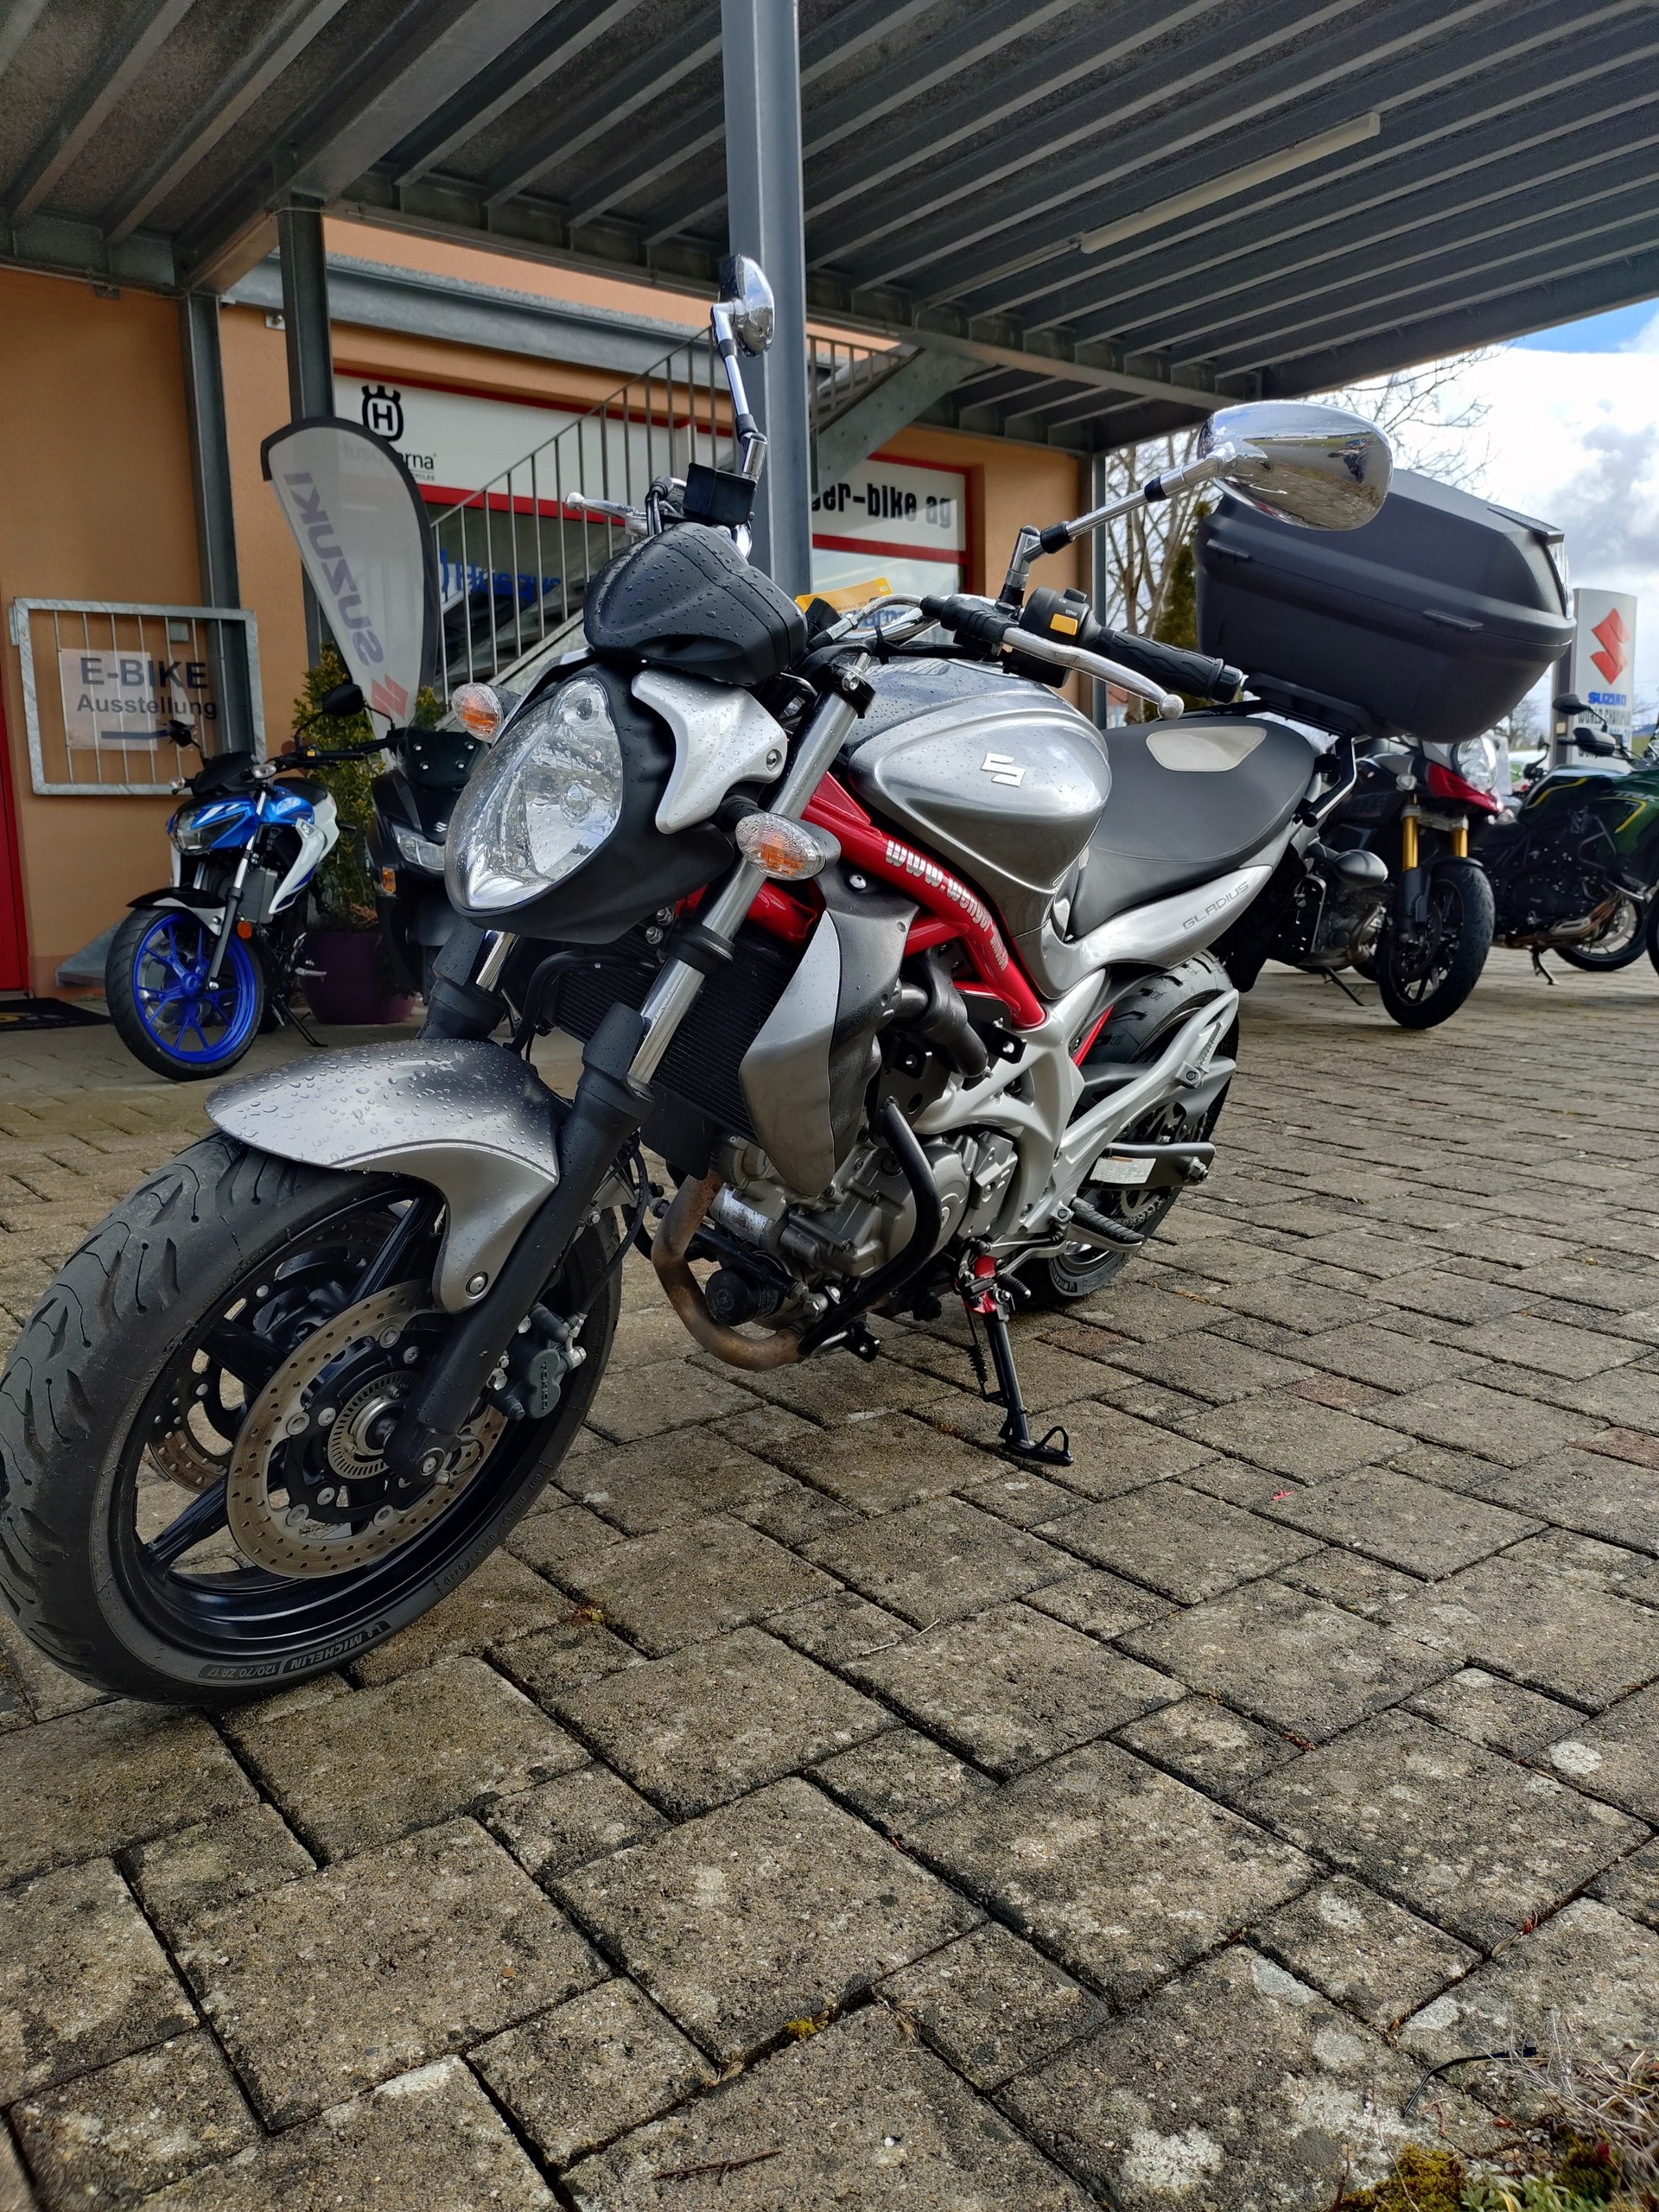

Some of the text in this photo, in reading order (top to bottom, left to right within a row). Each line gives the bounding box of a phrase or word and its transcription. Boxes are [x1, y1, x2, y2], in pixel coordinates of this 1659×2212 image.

[925, 495, 952, 529] ag
[79, 657, 208, 690] E-BIKE
[76, 694, 217, 720] Ausstellung
[1182, 881, 1249, 930] GLADIUS
[207, 1635, 364, 1678] MICHELIN 120/70 ZR 17
